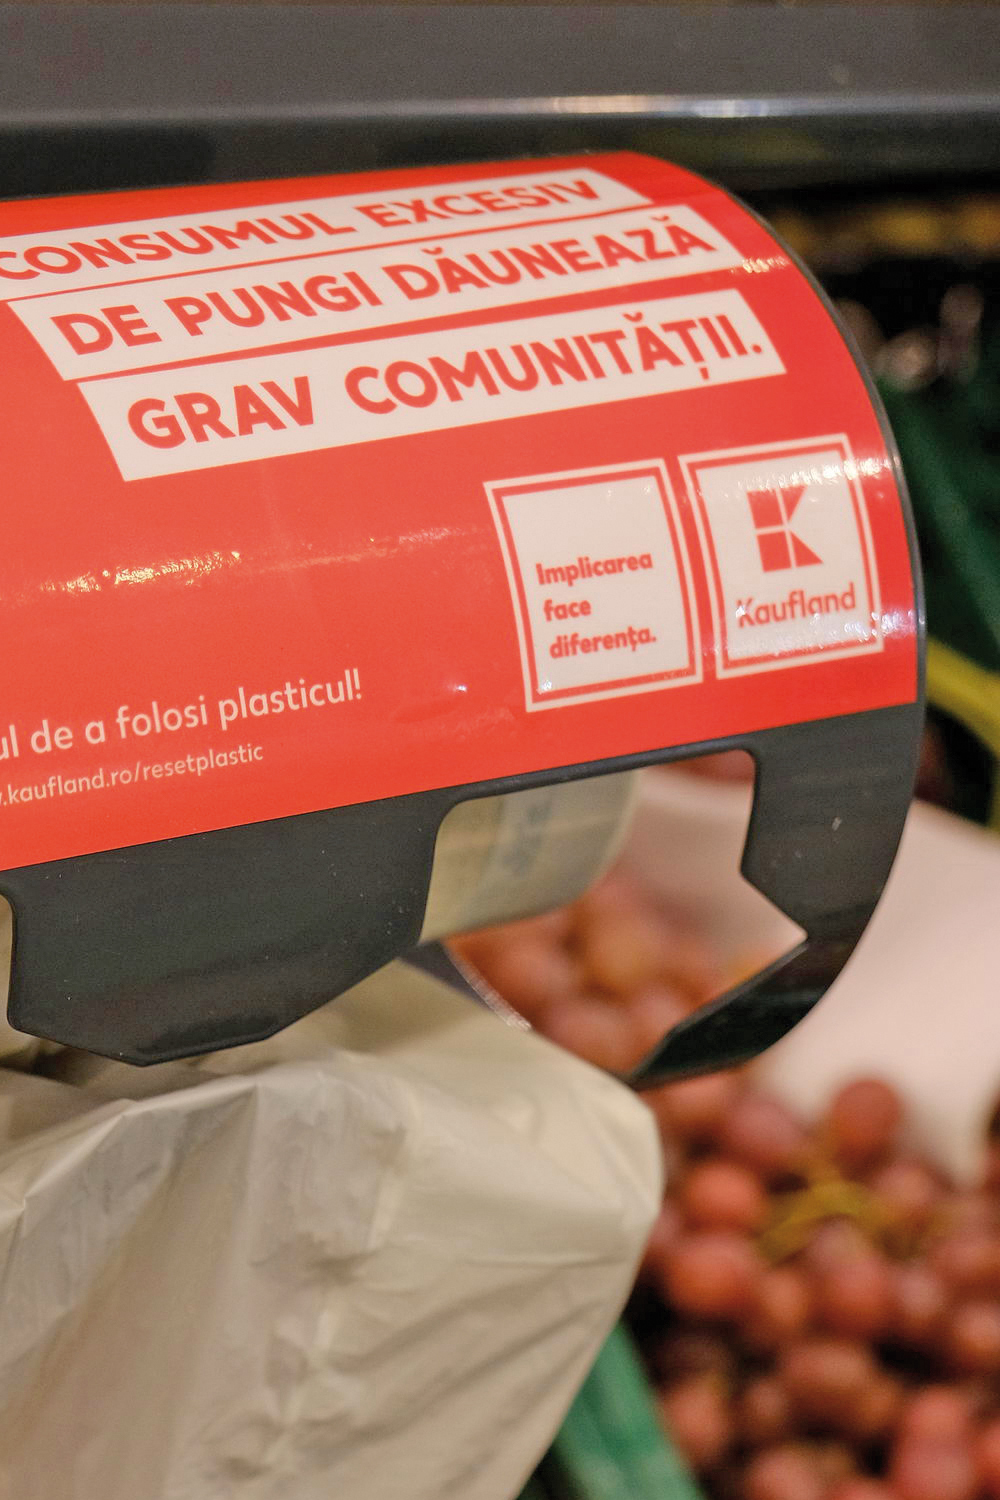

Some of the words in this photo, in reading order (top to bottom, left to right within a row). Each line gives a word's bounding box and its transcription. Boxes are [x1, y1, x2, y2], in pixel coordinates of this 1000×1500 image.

[356, 180, 600, 228] EXCESIV
[51, 306, 163, 356] DE
[167, 272, 383, 334] PUNGI
[386, 215, 718, 300] DĂUNEAZĂ
[128, 375, 315, 449] GRAV
[345, 312, 764, 414] COMUNITĂȚII.
[536, 553, 654, 587] Implicarea
[543, 599, 592, 622] face
[738, 583, 857, 628] Kaufland
[30, 718, 74, 754] de
[85, 717, 105, 745] a
[115, 695, 209, 740] folosi
[218, 668, 363, 731] plasticul!
